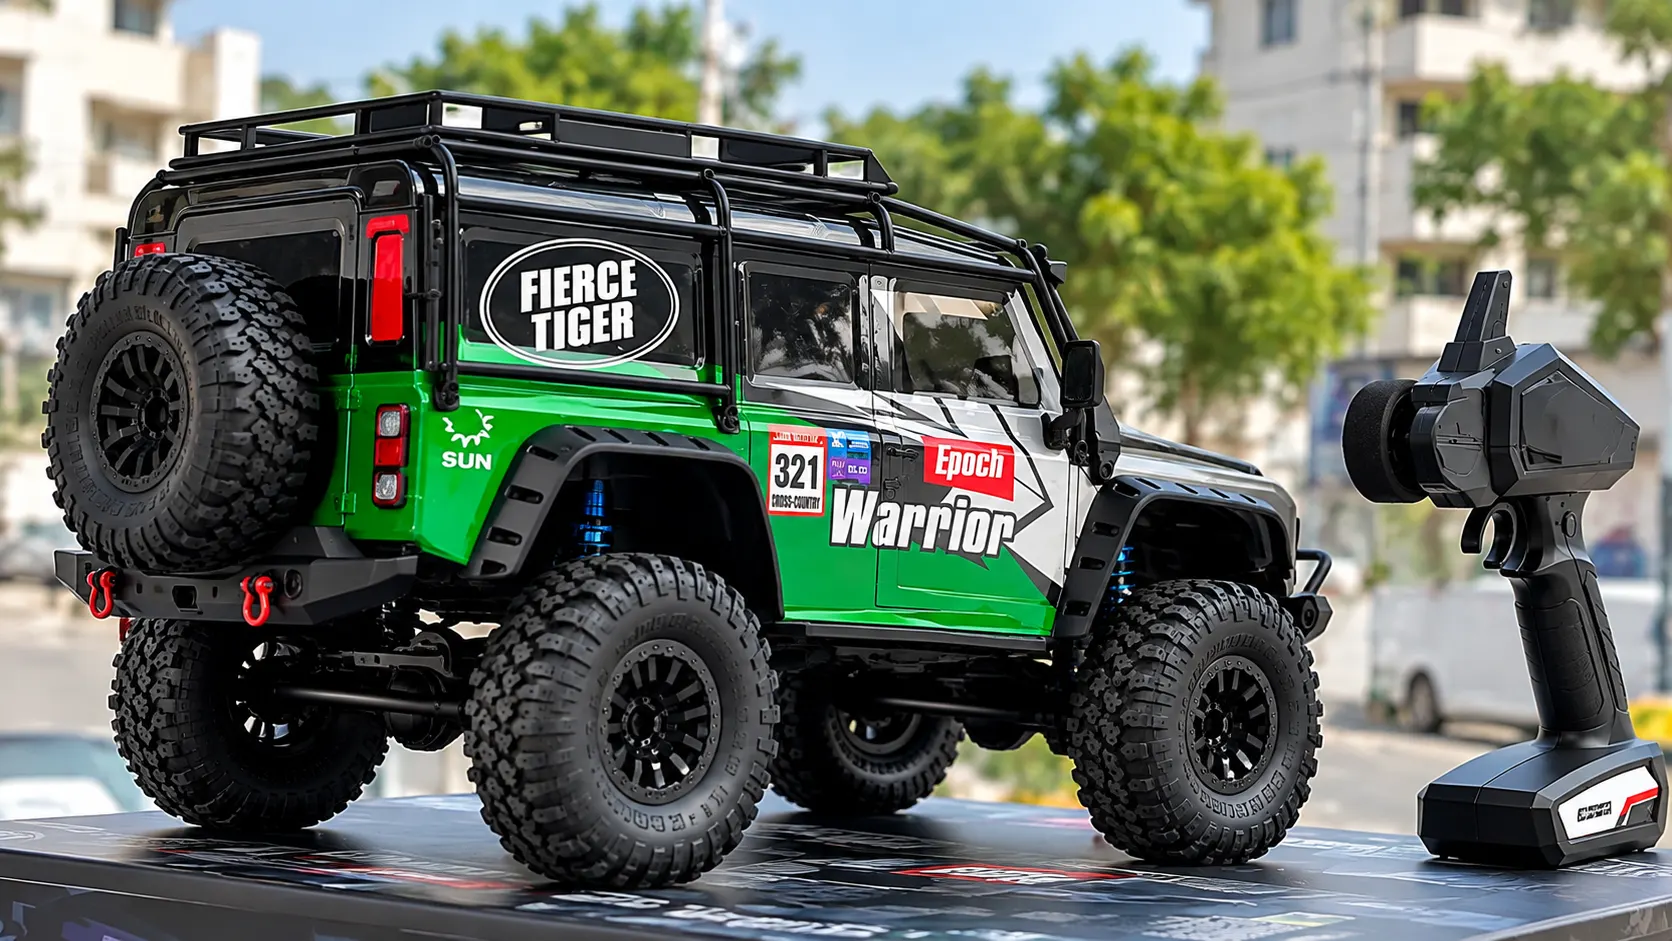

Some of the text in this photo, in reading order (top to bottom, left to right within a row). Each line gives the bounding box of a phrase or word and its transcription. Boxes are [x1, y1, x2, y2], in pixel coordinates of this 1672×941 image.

[520, 259, 637, 313] FIERCE
[531, 300, 634, 352] TIGER
[441, 450, 492, 470] SUN
[774, 453, 818, 490] 321
[935, 444, 1004, 481] Epoch
[772, 494, 820, 510] CROSS-COUNTRY
[830, 487, 1016, 556] Warrior
